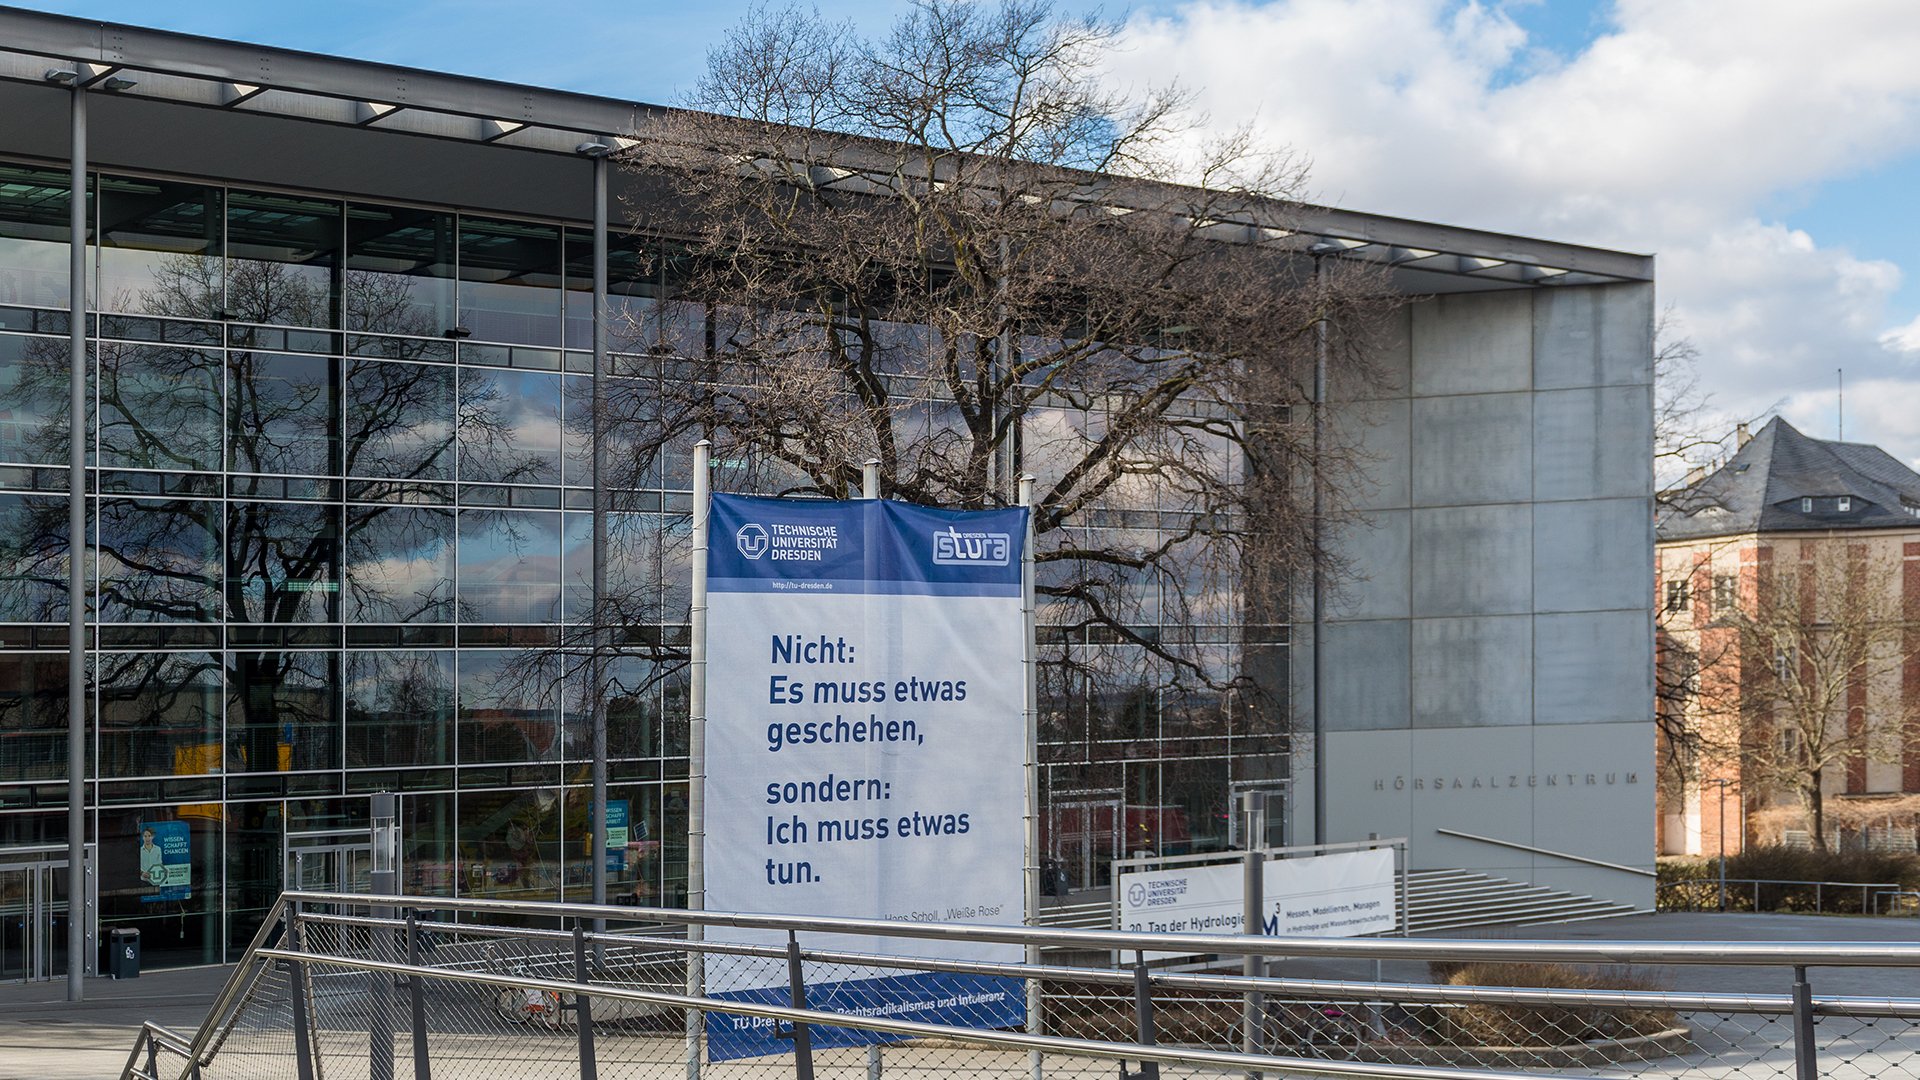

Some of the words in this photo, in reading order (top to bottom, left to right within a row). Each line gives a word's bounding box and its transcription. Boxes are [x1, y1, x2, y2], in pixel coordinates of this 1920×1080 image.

[772, 525, 837, 536] TECHNISCHE
[772, 537, 838, 549] UNIVERSITÄT
[772, 550, 821, 561] DRESDEN
[772, 582, 833, 590] http://tu-dresden.de
[771, 635, 855, 664] Nicht:
[769, 675, 804, 704] Es
[813, 681, 886, 704] muss
[894, 676, 967, 702] etwas
[767, 714, 924, 752] geschehen,
[766, 774, 891, 804] sondern:
[1374, 772, 1638, 791] HÖRSAALZENTRUM
[767, 815, 807, 845] Ich
[817, 817, 889, 842] muss
[897, 811, 970, 838] etwas
[766, 858, 821, 885] tun.
[1148, 879, 1188, 889] TECHNISCHE
[1147, 897, 1177, 907] DRESDEN
[1286, 909, 1312, 919] Messen,
[1353, 900, 1381, 911] Managen
[1148, 921, 1167, 932] Tag
[1169, 919, 1187, 932] der
[1190, 913, 1245, 931] Hydrologie
[753, 1015, 794, 1028] Dresd
